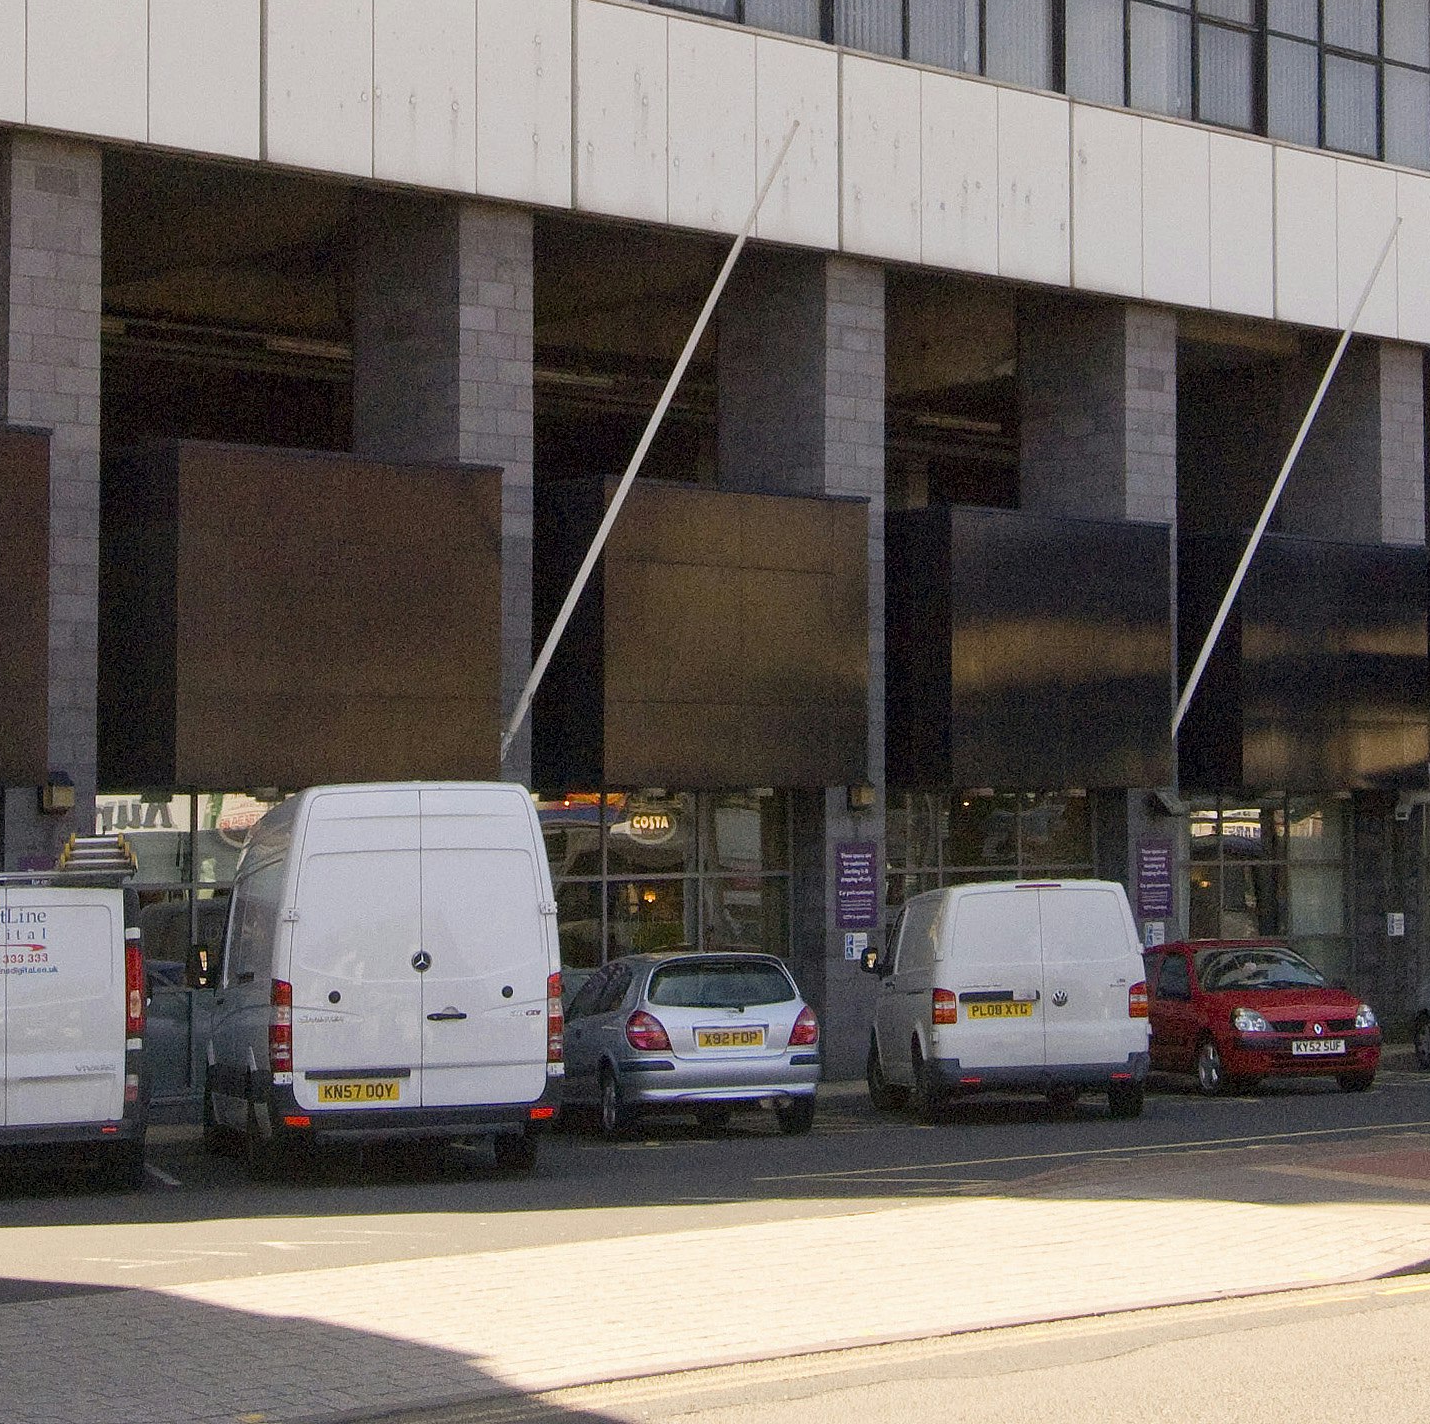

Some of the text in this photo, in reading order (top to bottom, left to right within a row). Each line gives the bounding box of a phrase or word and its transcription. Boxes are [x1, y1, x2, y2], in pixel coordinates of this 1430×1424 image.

[632, 816, 669, 829] COSTA
[2, 954, 24, 964] 333
[27, 952, 48, 963] 333
[323, 1084, 362, 1100] KN57
